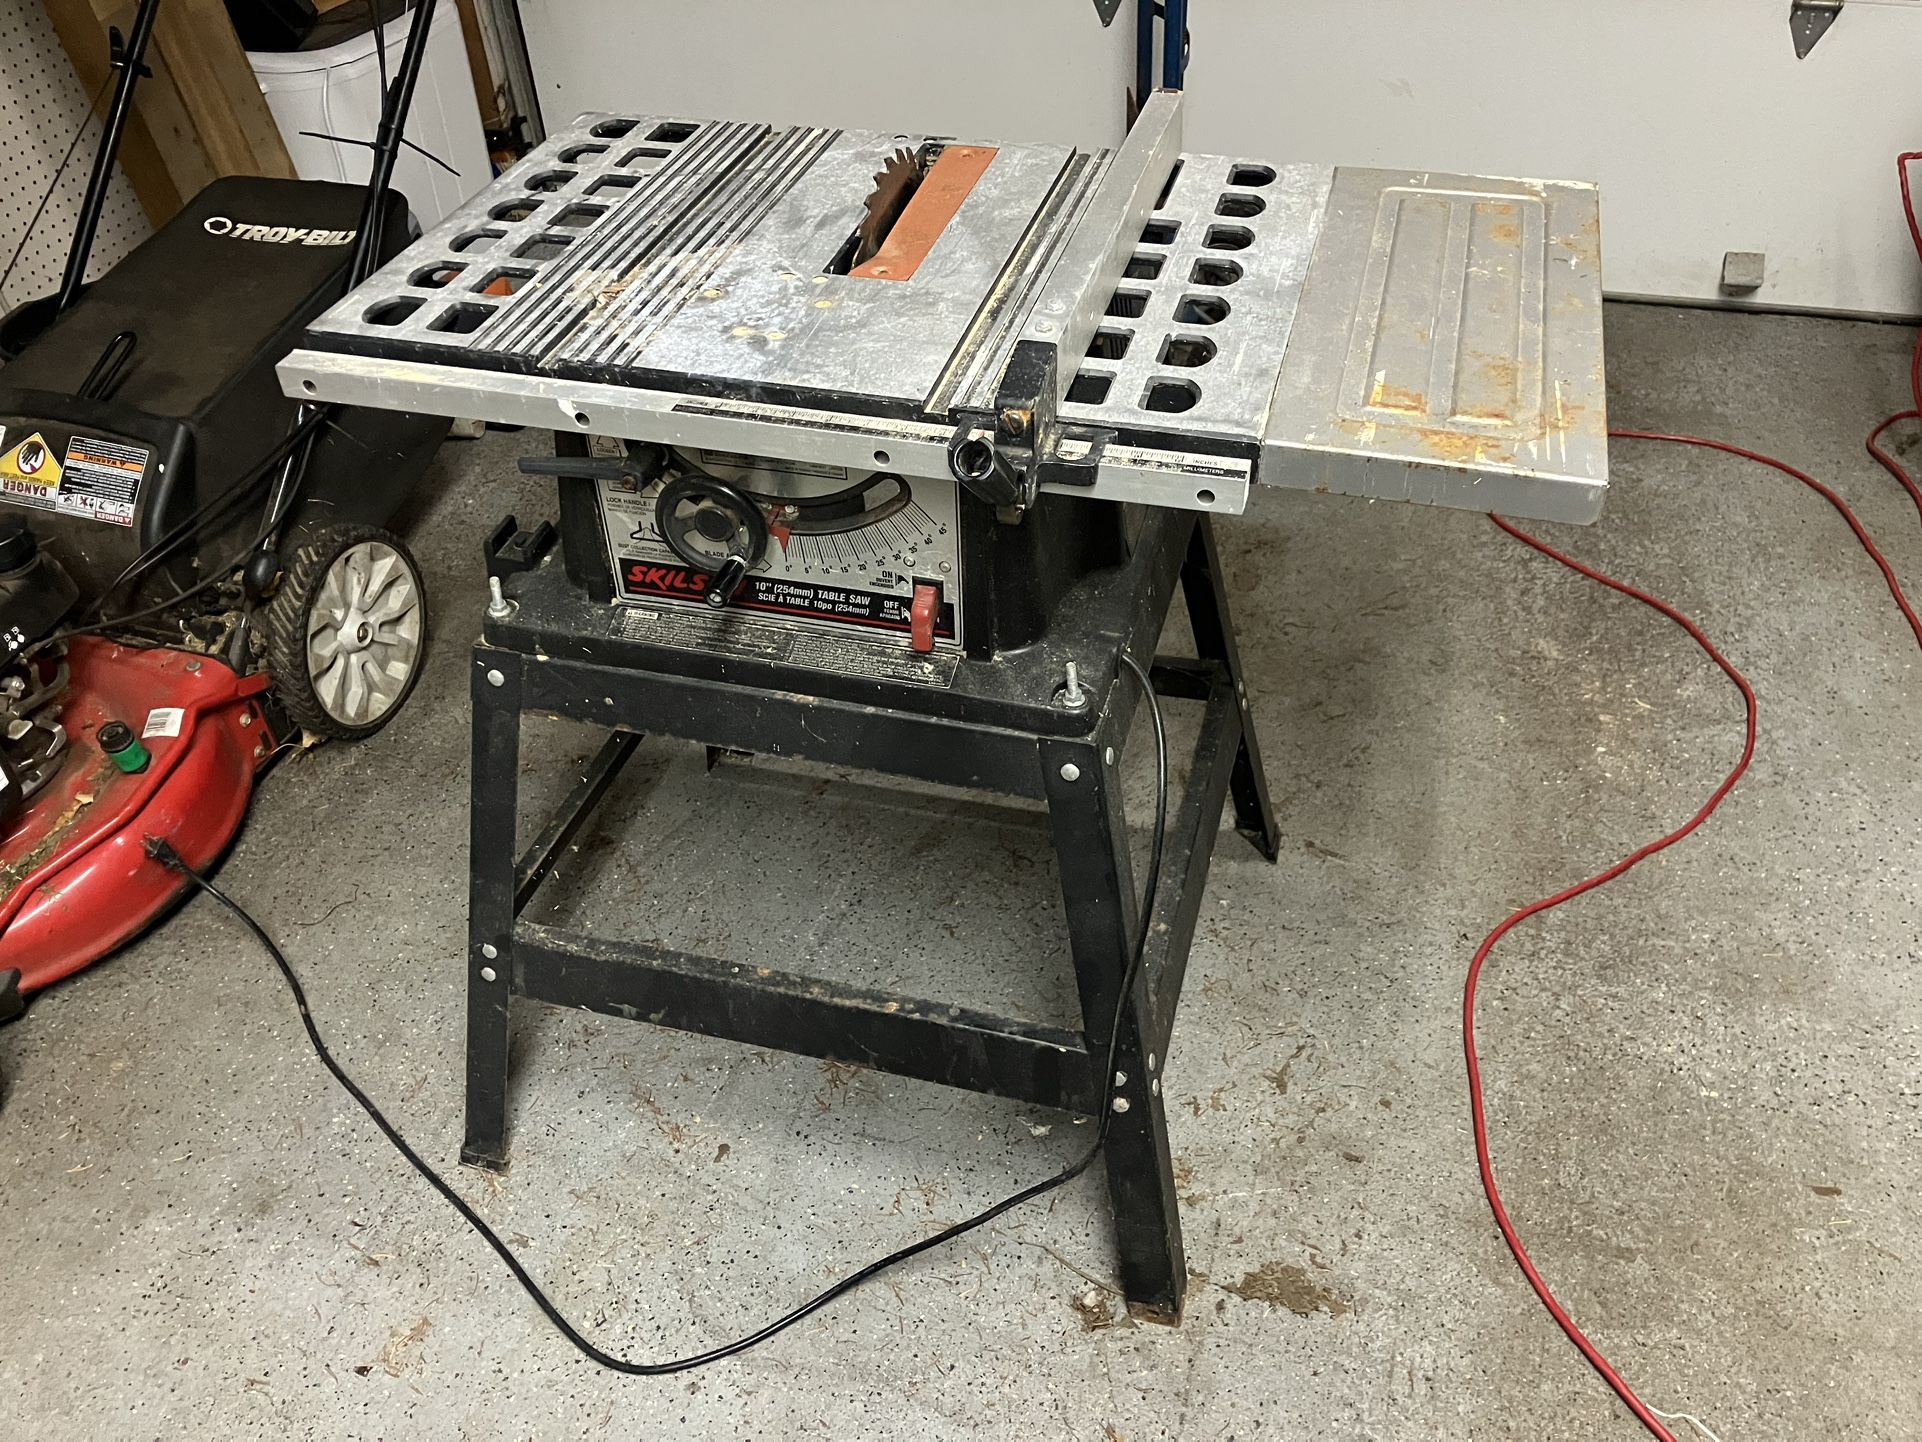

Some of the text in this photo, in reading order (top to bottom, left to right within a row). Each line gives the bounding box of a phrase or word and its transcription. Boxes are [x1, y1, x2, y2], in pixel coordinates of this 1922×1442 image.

[83, 455, 117, 466] WARNING
[3, 479, 47, 497] DANGER
[938, 522, 947, 535] 45°
[924, 533, 932, 545] 40°
[909, 542, 918, 554] 35°
[704, 550, 725, 558] BLADE
[892, 549, 901, 561] 30°
[858, 560, 867, 571] 20°
[876, 555, 886, 567] 25°
[785, 564, 792, 572] 0°
[804, 565, 812, 574] 5°
[821, 565, 832, 574] 10°
[840, 563, 851, 573] 15°
[882, 570, 893, 578] ON
[755, 582, 871, 606] 10" (254mm) TABLE SAW
[758, 592, 870, 616] SCIE À TABLE 10po (254mm)
[884, 600, 899, 609] OFF
